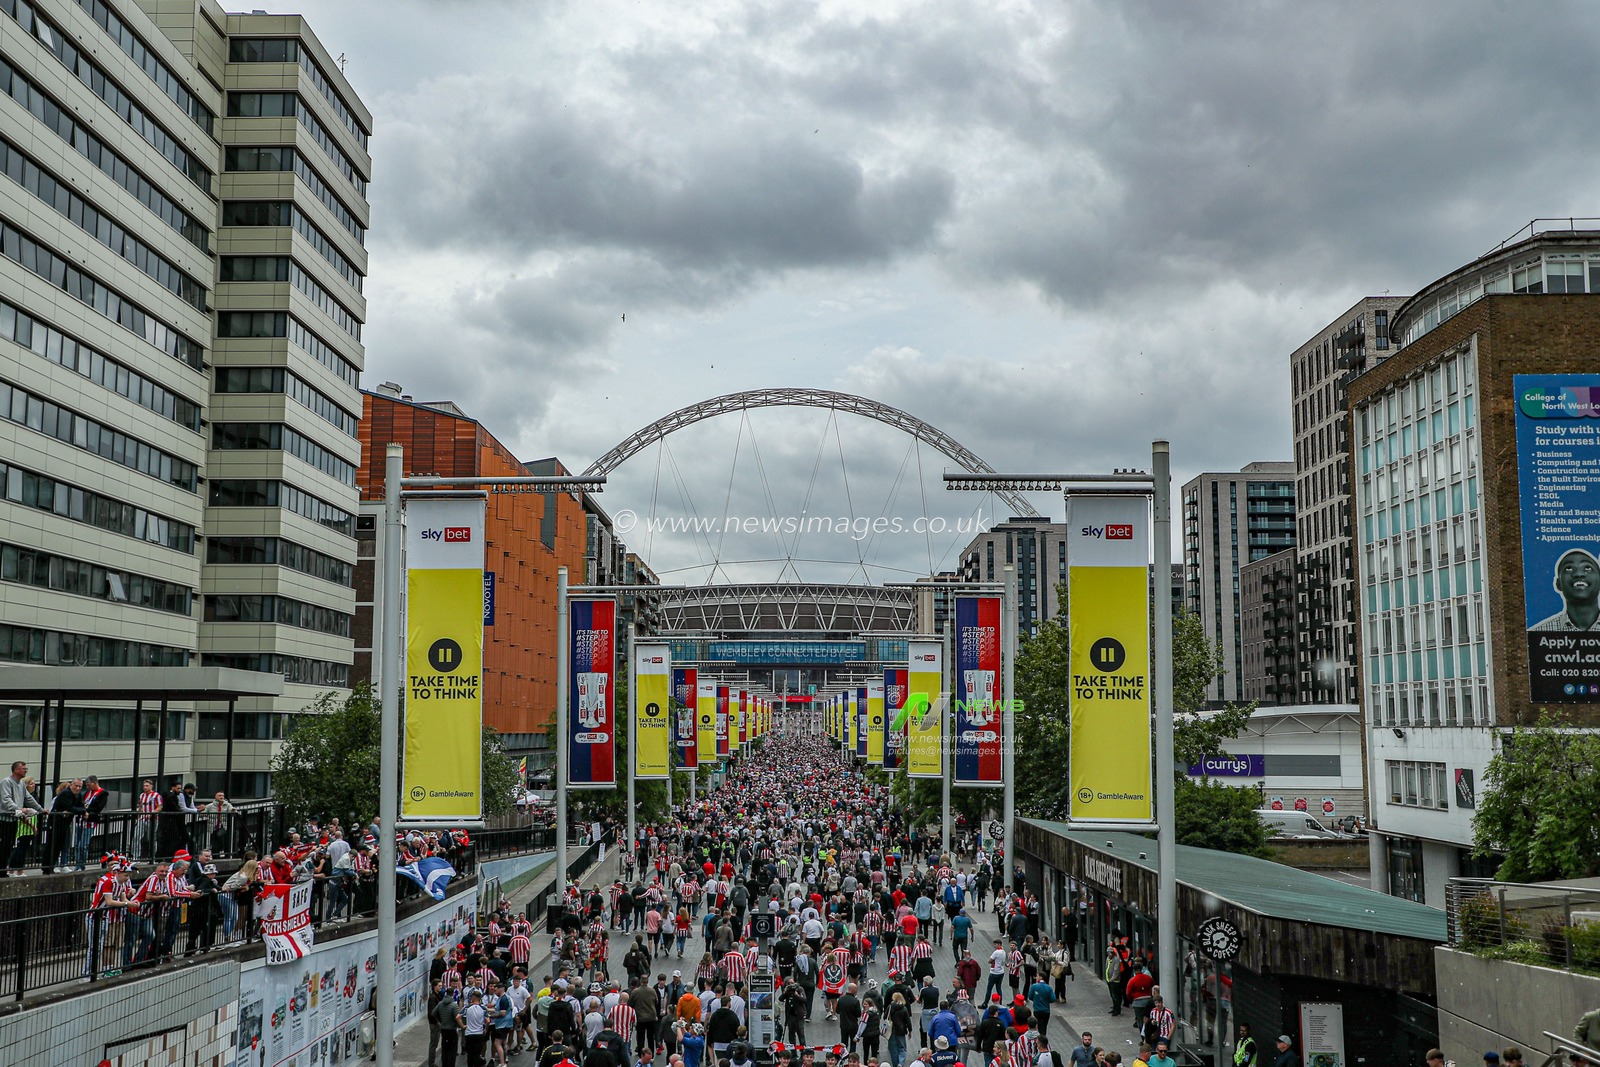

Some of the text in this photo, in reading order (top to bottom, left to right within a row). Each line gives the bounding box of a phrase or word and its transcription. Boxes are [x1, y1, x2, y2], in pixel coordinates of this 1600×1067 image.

[1524, 393, 1556, 402] College
[1535, 426, 1567, 436] Study
[1569, 425, 1594, 434] with
[1535, 437, 1550, 446] for
[421, 528, 468, 542] sky bet
[1082, 525, 1130, 538] sky bet
[1539, 636, 1576, 649] Apply
[716, 648, 858, 658] WEMBLEY CONNECTED BY EE
[1545, 650, 1600, 663] cnwl.ac
[410, 676, 478, 686] TAKE TIME
[1074, 676, 1144, 687] TAKE TIME
[412, 688, 476, 699] TO THINK
[1075, 688, 1142, 700] TO THINK
[1206, 760, 1247, 772] currys
[1202, 922, 1238, 959] BLACK SHEEP COFFEE
